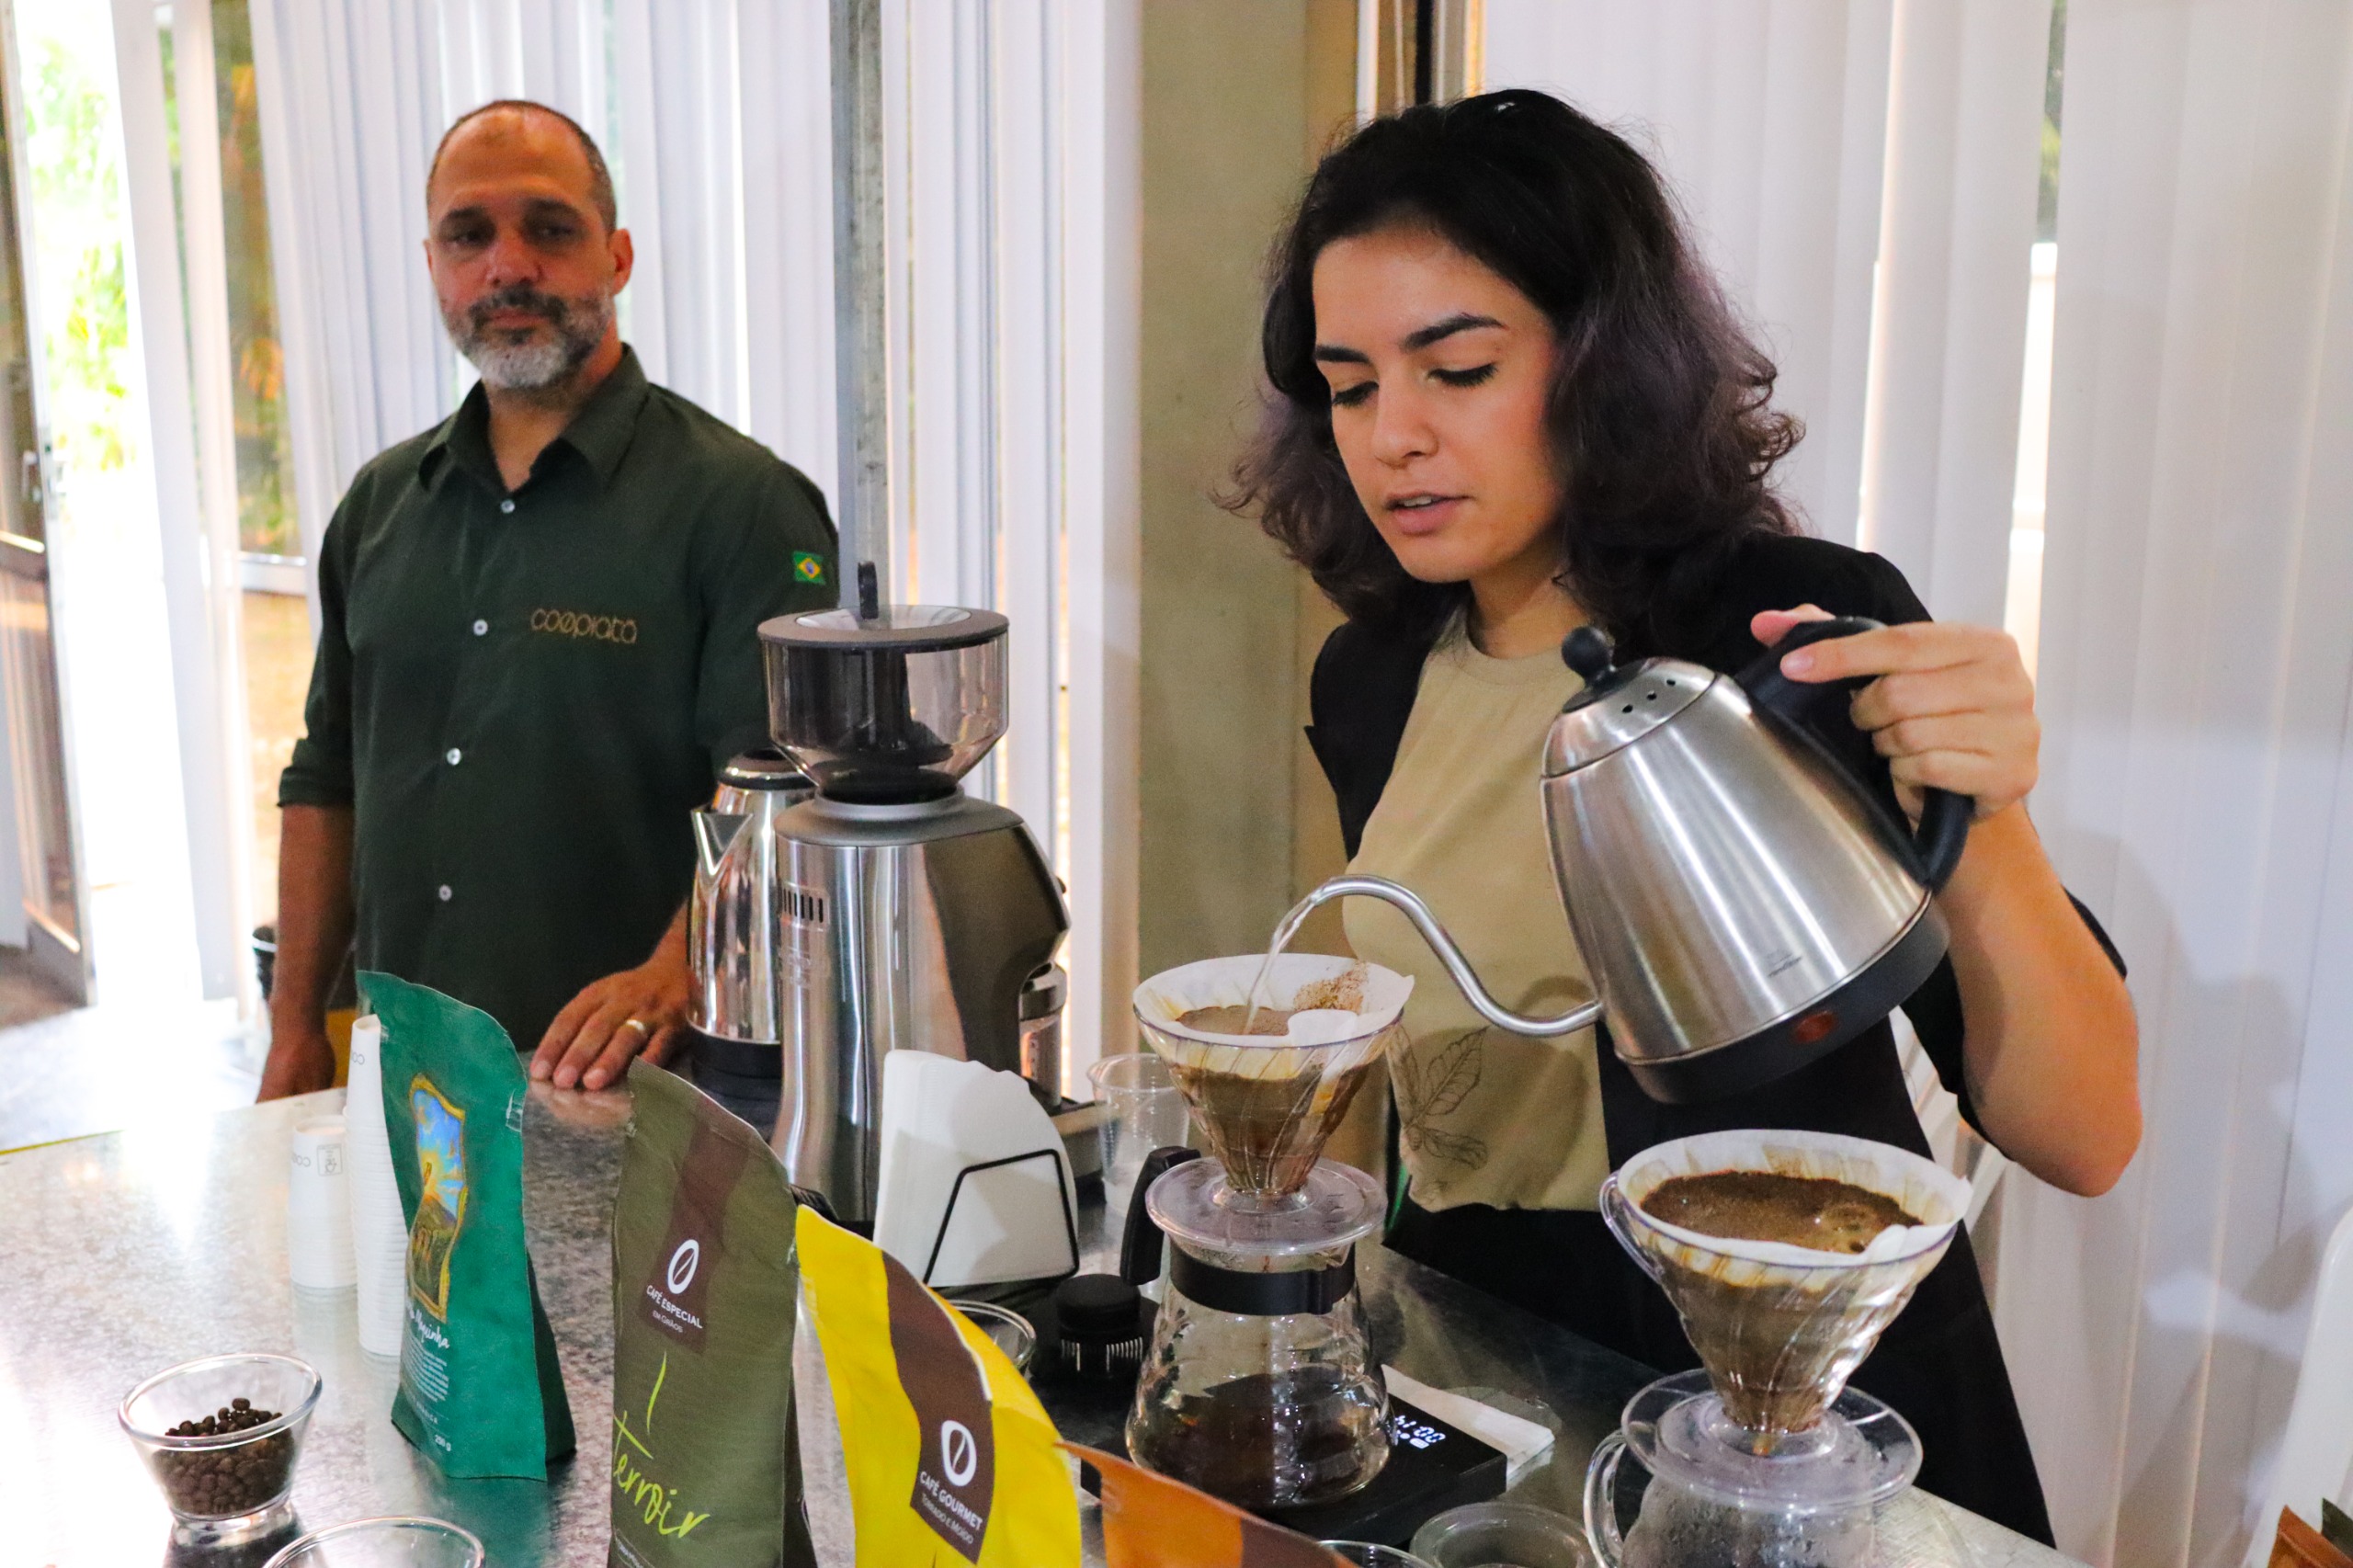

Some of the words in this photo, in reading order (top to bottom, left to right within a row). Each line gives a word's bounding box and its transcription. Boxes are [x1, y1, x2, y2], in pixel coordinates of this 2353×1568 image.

[646, 1284, 663, 1304] CAFÉ
[661, 1298, 703, 1329] ESPECIAL
[612, 1410, 711, 1539] terroir
[920, 1471, 939, 1496] CAFÉ
[938, 1489, 983, 1530] GOURMET
